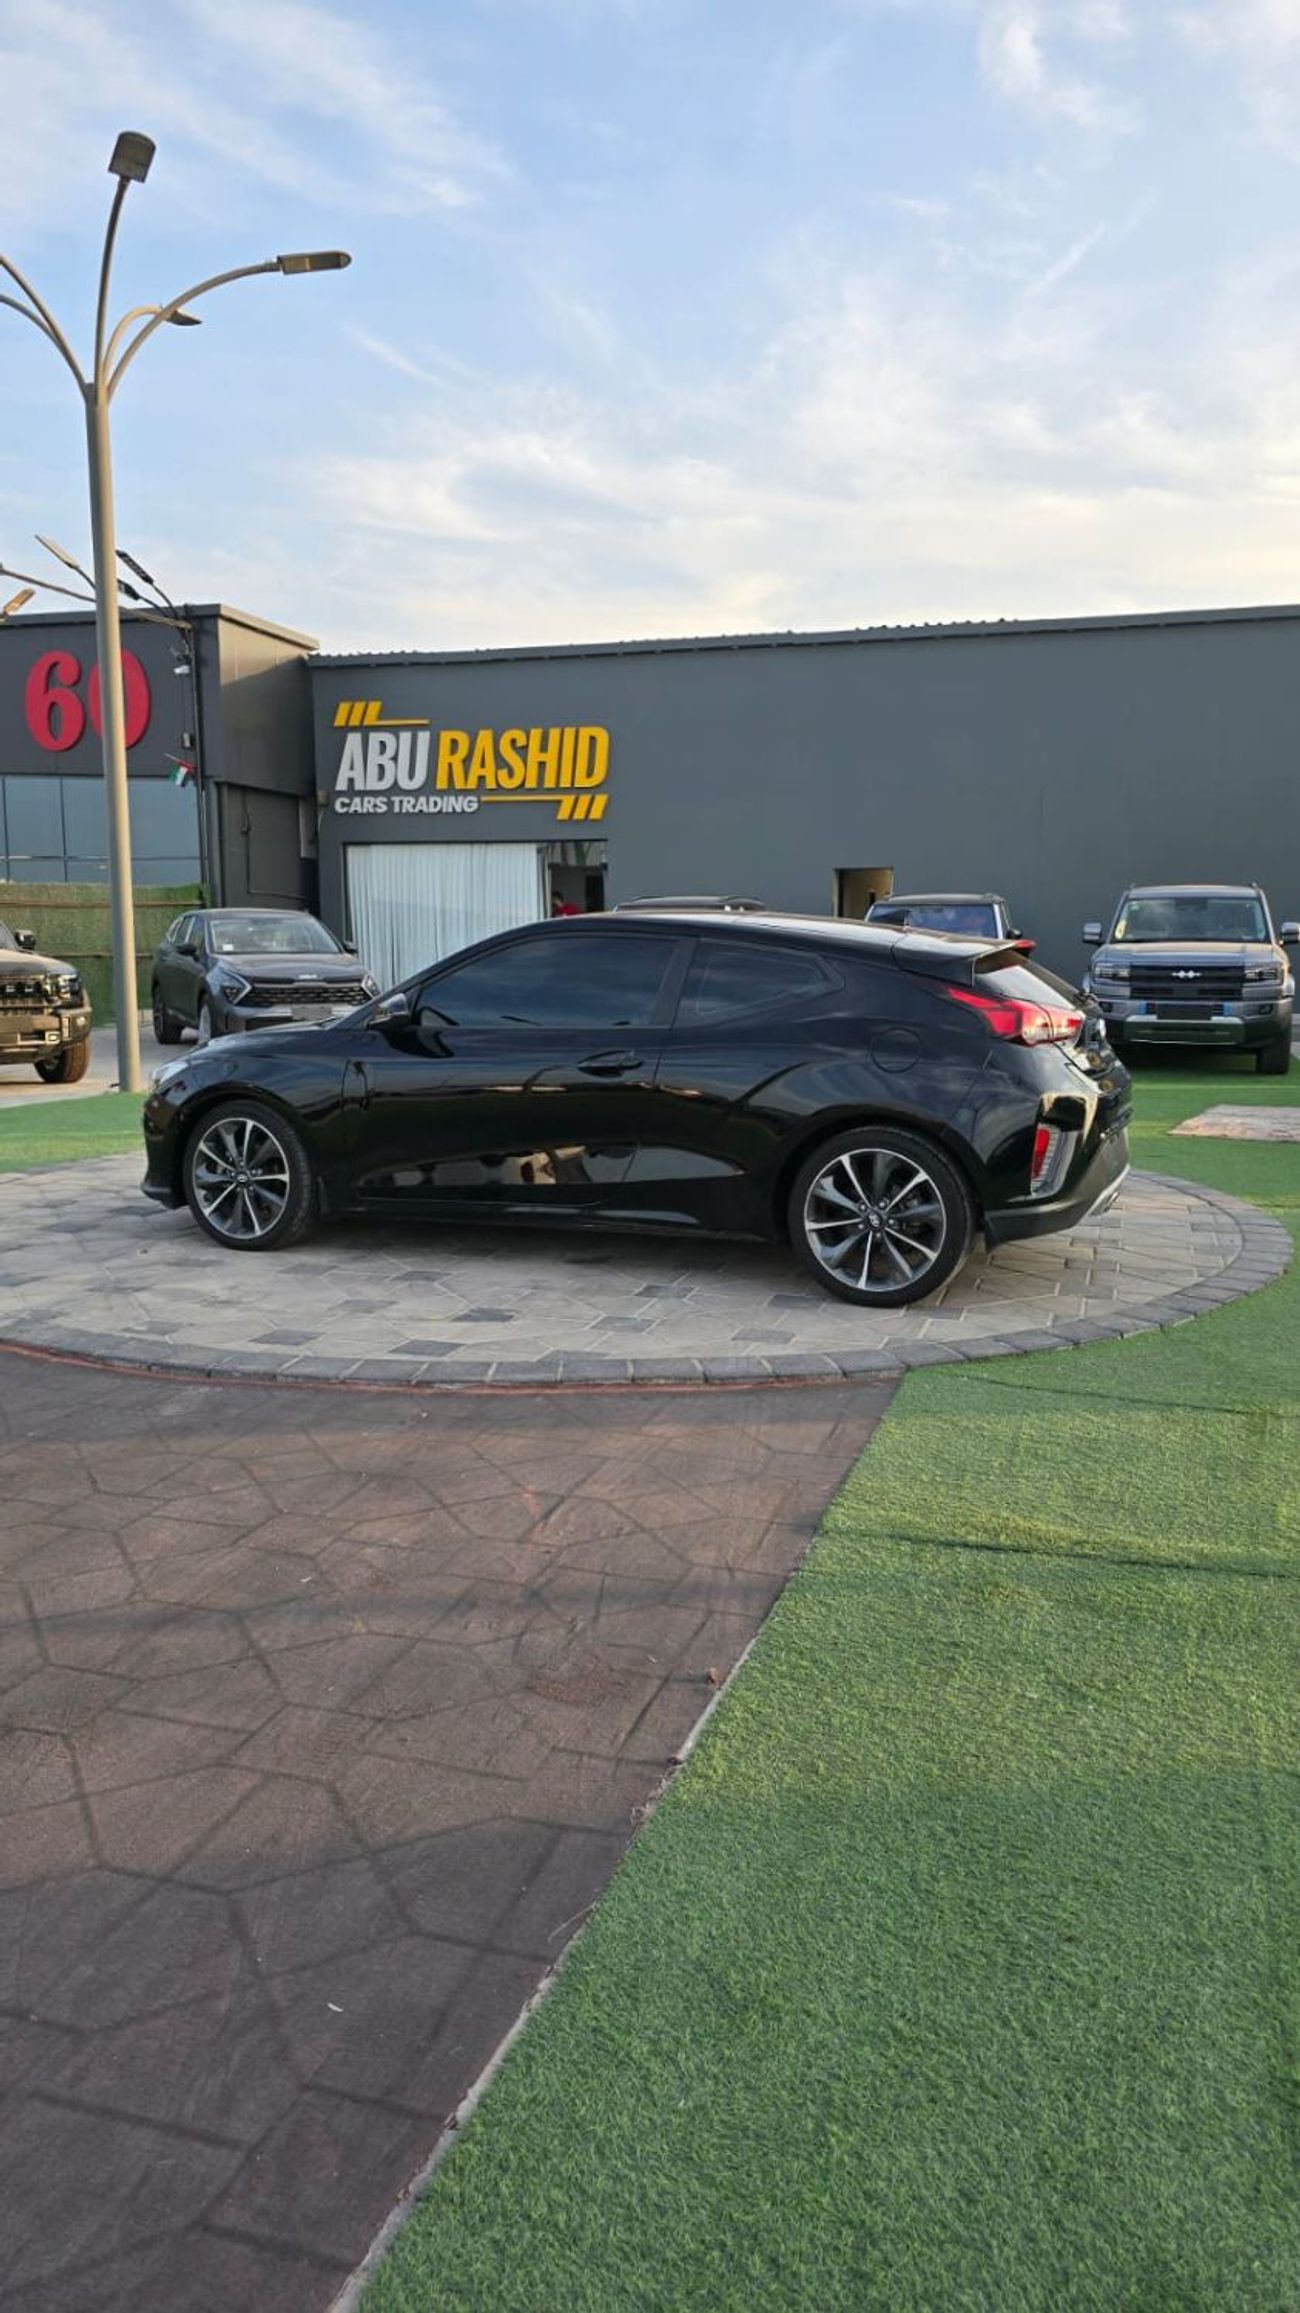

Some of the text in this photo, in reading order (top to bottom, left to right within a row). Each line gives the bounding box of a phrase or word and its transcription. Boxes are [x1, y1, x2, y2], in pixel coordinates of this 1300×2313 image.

[25, 649, 151, 752] 60
[335, 726, 610, 791] ABU RASHID
[334, 796, 479, 814] CARS TRADING
